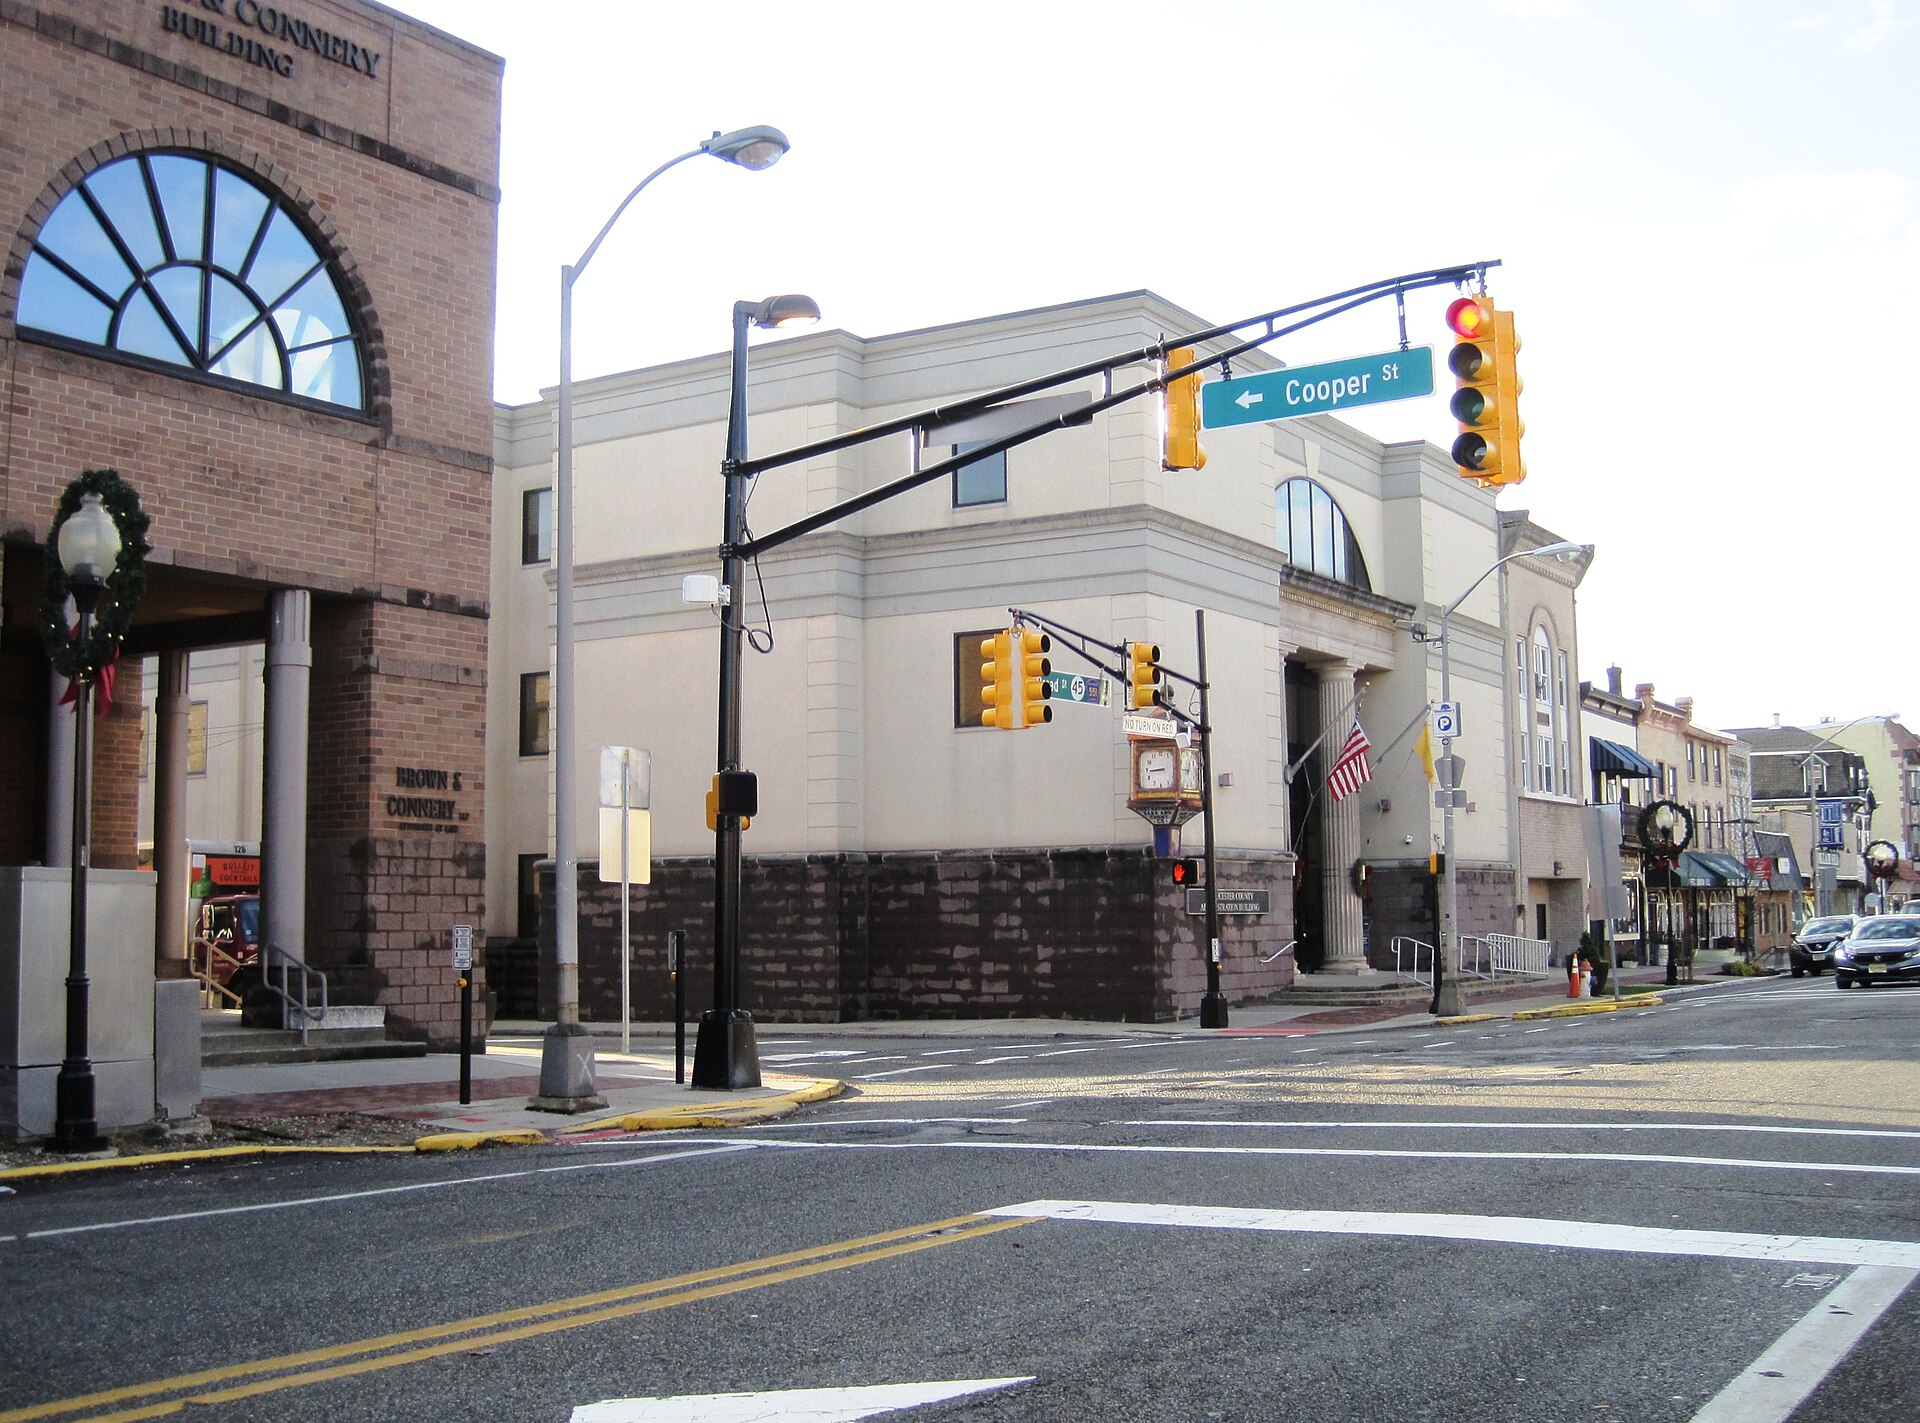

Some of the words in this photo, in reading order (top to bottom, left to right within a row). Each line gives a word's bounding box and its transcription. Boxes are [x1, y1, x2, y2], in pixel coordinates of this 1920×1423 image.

[163, 5, 294, 78] BUILDING
[235, 0, 380, 78] CONNERY
[1285, 372, 1371, 405] Cooper
[1382, 363, 1399, 382] St
[1072, 681, 1084, 695] 45
[1125, 718, 1134, 730] NO
[1135, 719, 1151, 731] TURN
[1152, 722, 1161, 732] ON
[1162, 723, 1174, 734] RED
[396, 767, 448, 790] BROWN
[452, 772, 463, 792] &
[386, 796, 456, 820] CONNERY
[220, 874, 259, 883] COCKTAILS
[1235, 892, 1255, 901] COUNTY
[1239, 903, 1260, 912] BUILDING
